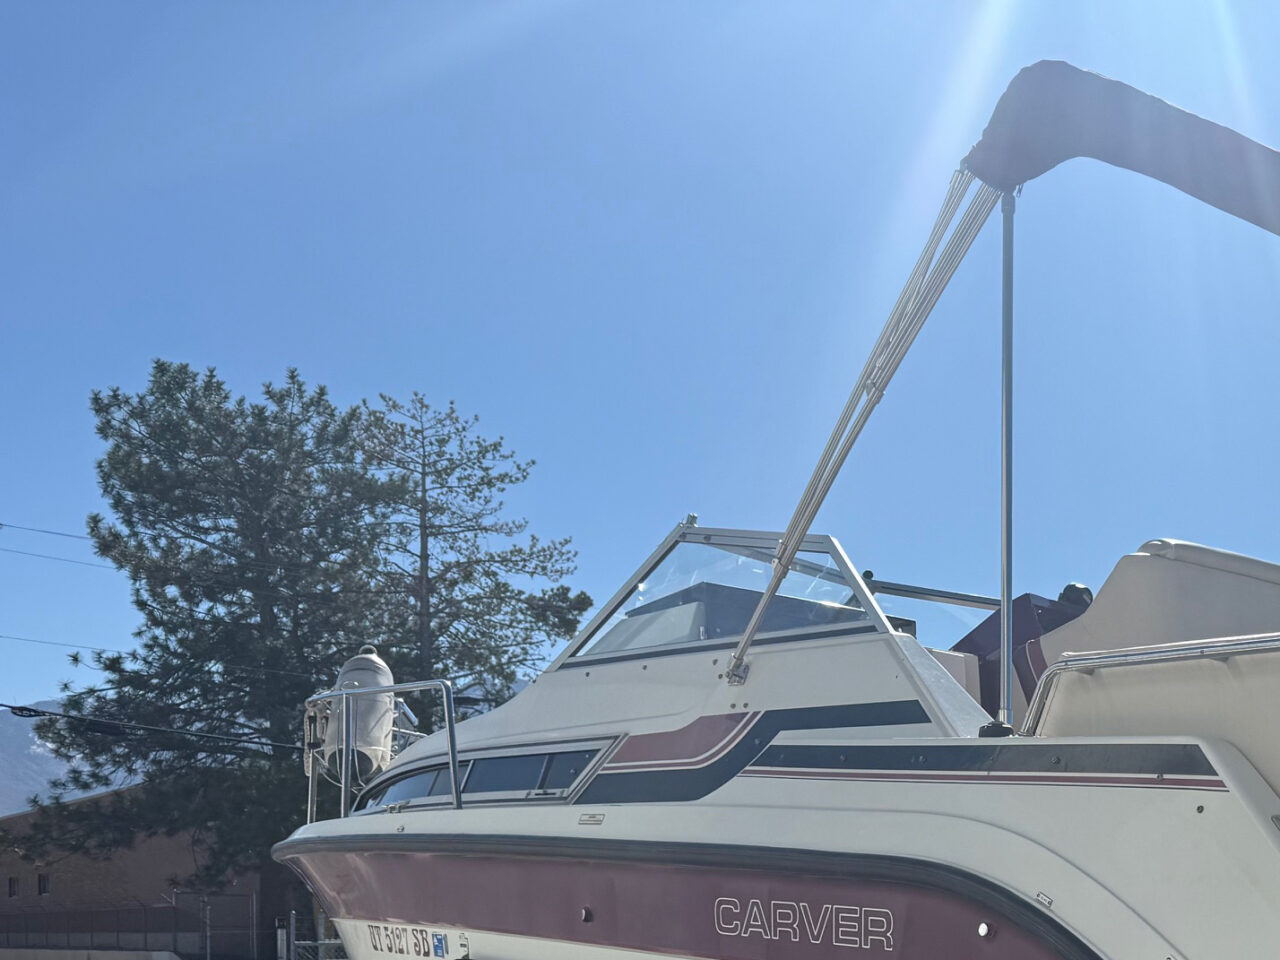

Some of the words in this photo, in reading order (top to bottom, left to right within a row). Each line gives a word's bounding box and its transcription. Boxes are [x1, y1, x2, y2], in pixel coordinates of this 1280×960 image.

[368, 924, 383, 952] UT
[384, 926, 410, 955] 5127
[411, 928, 431, 958] SB
[713, 897, 895, 951] CARVER
